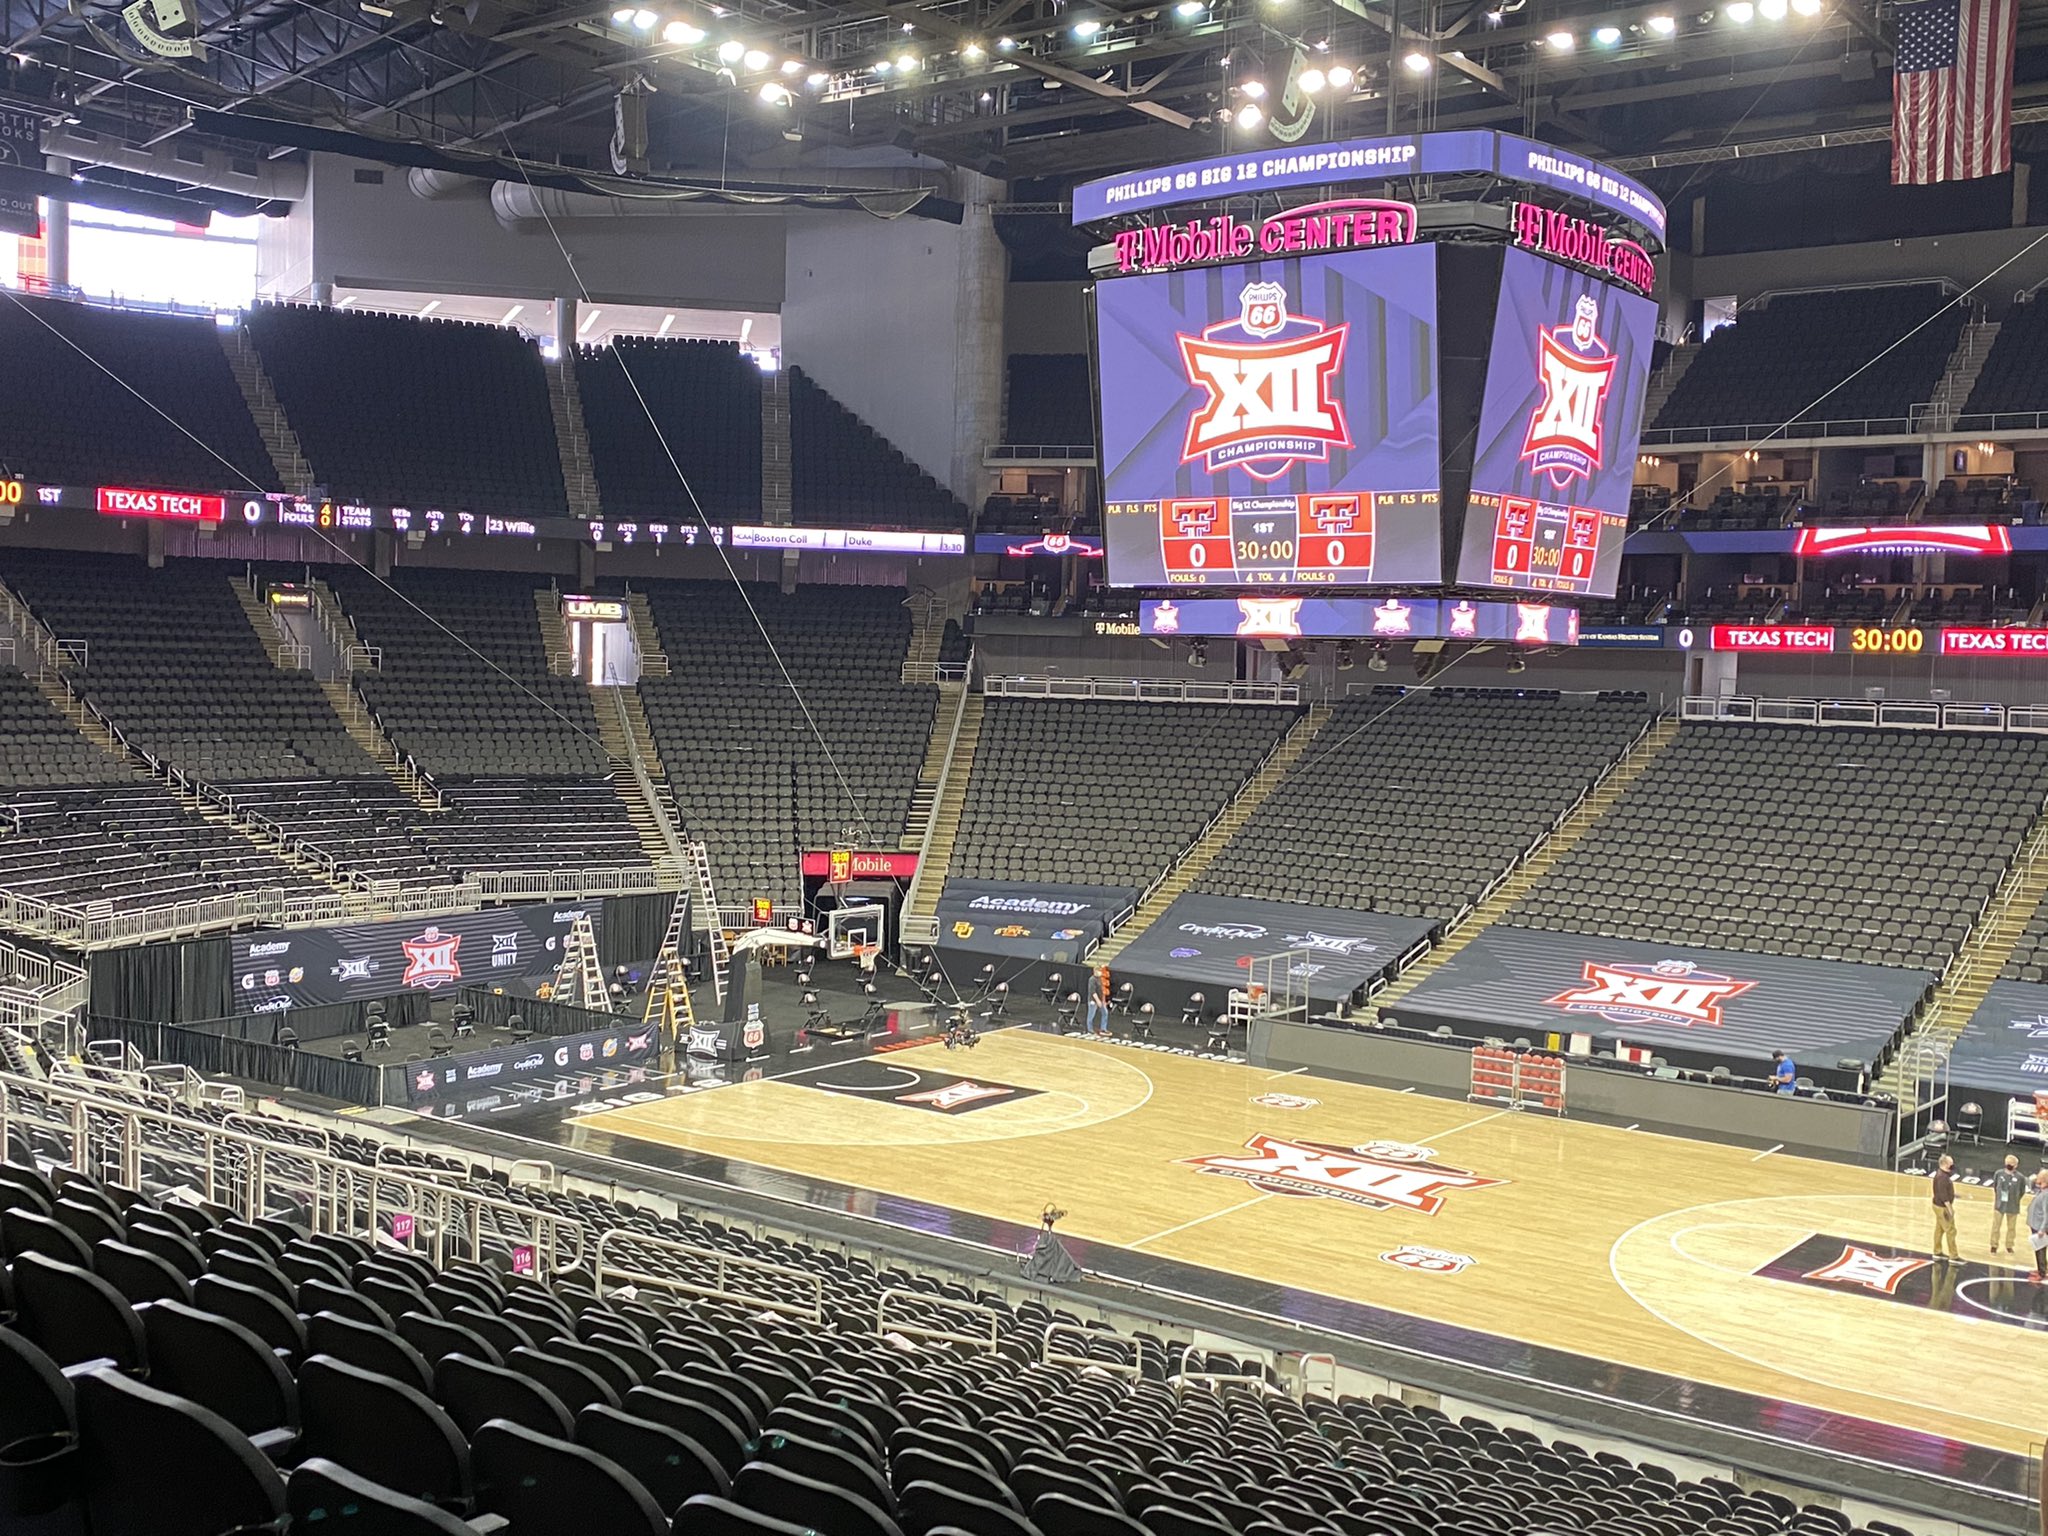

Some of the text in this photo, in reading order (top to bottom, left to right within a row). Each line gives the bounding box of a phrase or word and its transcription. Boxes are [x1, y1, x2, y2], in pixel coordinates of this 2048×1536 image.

[1106, 145, 1416, 204] PHILLIPS 66 BIG 12 CHAMPIONSHIP
[1528, 152, 1585, 183] PHILLIPS
[1586, 171, 1600, 190] 66
[1602, 177, 1618, 197] BIG
[1619, 184, 1629, 202] 12
[1260, 211, 1404, 254] CENTER
[1615, 246, 1652, 293] CENTER
[1249, 292, 1277, 302] PHILLIPS
[1250, 305, 1275, 325] 66
[1195, 343, 1334, 443] XII
[1532, 350, 1608, 450] XII
[1218, 439, 1316, 460] CHAMPIONSHIP
[1539, 450, 1587, 466] CHAMPIONSHIP
[38, 488, 61, 502] 1ST
[1378, 494, 1439, 505] PLR FLS PTS
[106, 491, 260, 521] TEXAS TECH 0
[294, 503, 330, 516] TOL 4
[343, 506, 371, 517] TEAM
[1108, 504, 1157, 514] PLR FLS PTS
[284, 513, 330, 526] FOULS 0
[343, 516, 372, 526] STATS
[394, 518, 471, 533] 14 5 4
[490, 520, 503, 531] 23
[1252, 522, 1275, 533] 1ST
[593, 531, 601, 541] 0
[624, 532, 632, 543] 2
[655, 533, 661, 544] 1
[686, 534, 694, 544] 2
[754, 533, 786, 543] Boston
[849, 537, 872, 546] Duke
[1049, 537, 1063, 546] 66
[1189, 543, 1206, 567] 0
[1237, 540, 1294, 560] 30:00
[1327, 540, 1345, 566] 0
[1507, 544, 1519, 569] 0
[1532, 546, 1561, 567] 30:00
[1572, 552, 1583, 576] 0
[1199, 574, 1206, 583] 0
[1245, 572, 1287, 583] 4 TOL 4
[1328, 572, 1335, 582] 0
[568, 601, 622, 614] UMB
[1679, 629, 1693, 647] 0
[1729, 631, 1828, 647] TEXAS TECH
[1852, 629, 1923, 651] 30:00
[1948, 633, 2006, 649] TEXAS
[834, 863, 846, 879] 30
[971, 896, 1088, 914] Academy
[249, 941, 291, 953] Academy
[546, 937, 555, 950] G
[408, 941, 456, 976] XII
[492, 952, 517, 967] UNITY
[1660, 966, 1687, 975] 66
[242, 973, 254, 989] G
[1566, 970, 1734, 1019] XII
[1579, 1004, 1682, 1021] CHAMPIONSHIP
[692, 1031, 717, 1055] XII
[747, 1031, 760, 1042] 66
[555, 1047, 569, 1066] G
[467, 1063, 503, 1076] Academy
[1204, 1140, 1478, 1206] XII
[1218, 1170, 1376, 1205] CHAMPIONSHIP
[396, 1219, 411, 1232] 117
[516, 1252, 531, 1264] 116
[1395, 1254, 1451, 1269] 66
